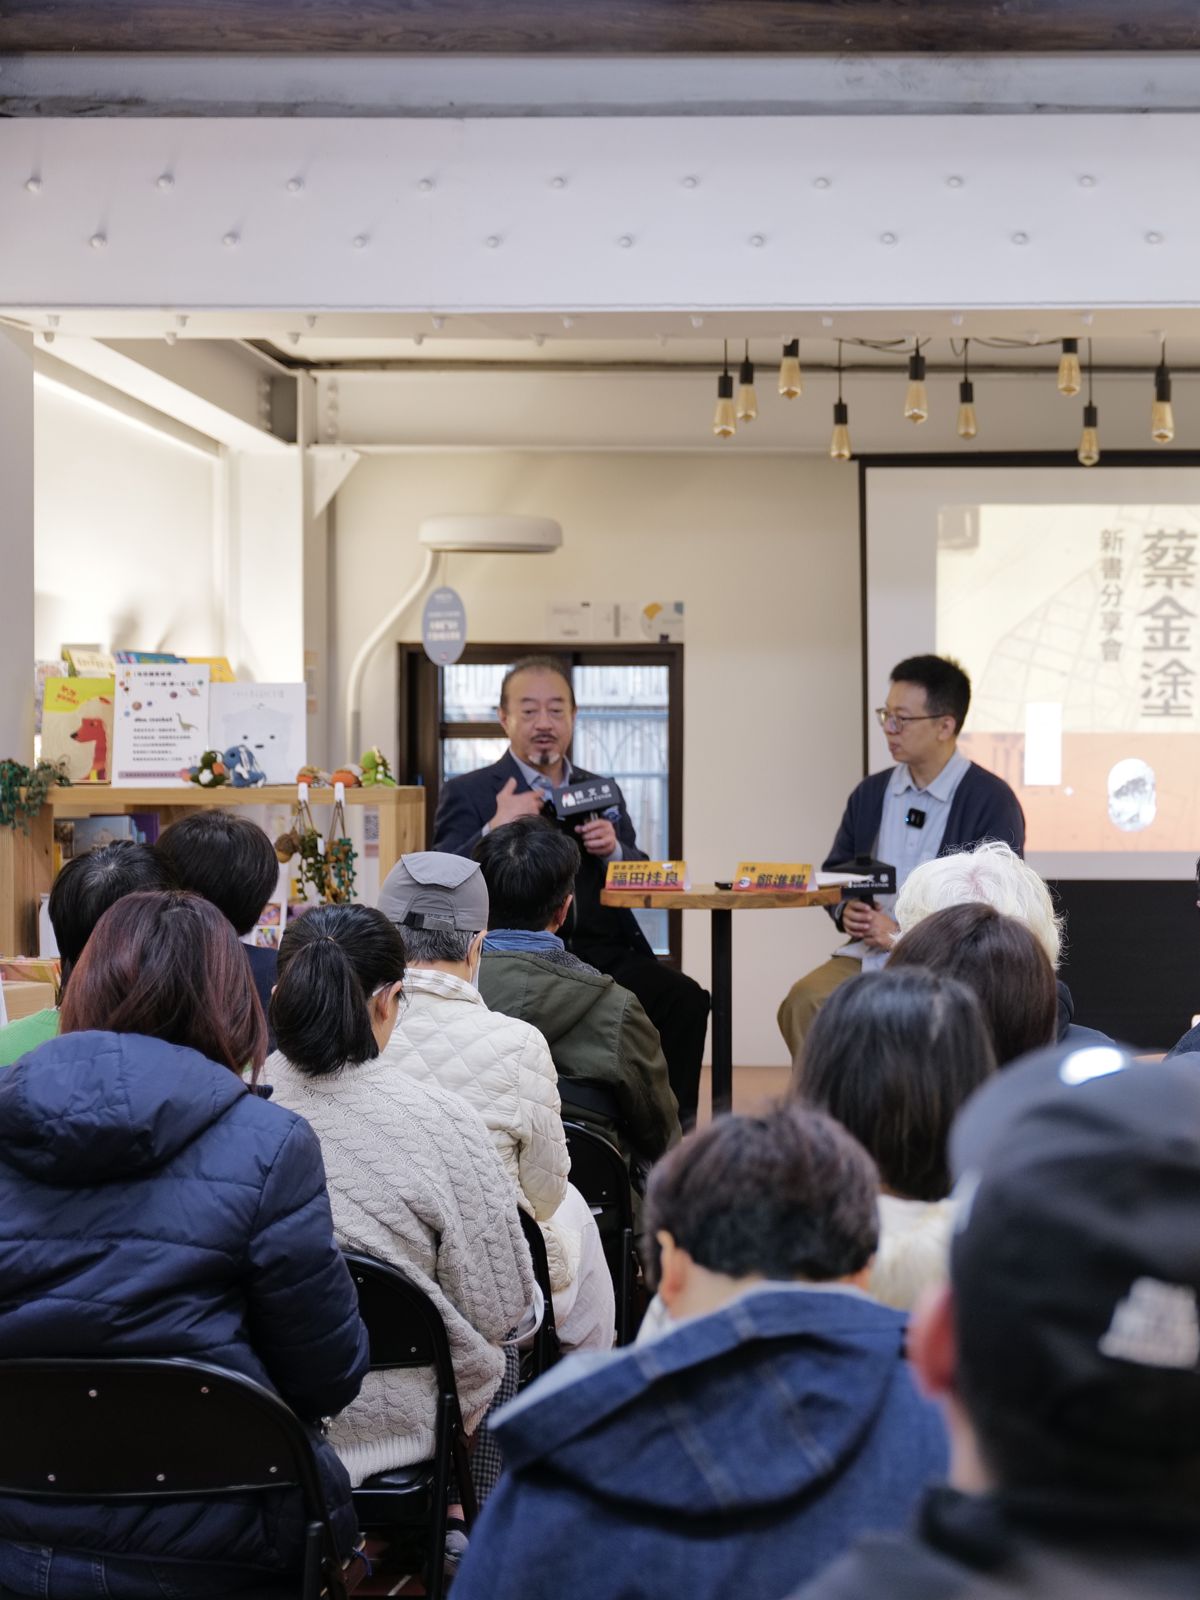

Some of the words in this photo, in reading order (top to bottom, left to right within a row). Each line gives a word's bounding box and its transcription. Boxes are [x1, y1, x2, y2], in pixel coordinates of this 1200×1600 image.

[1100, 528, 1125, 662] 新書分享會
[1138, 528, 1199, 718] 蔡金塗
[612, 871, 678, 886] 福田桂良
